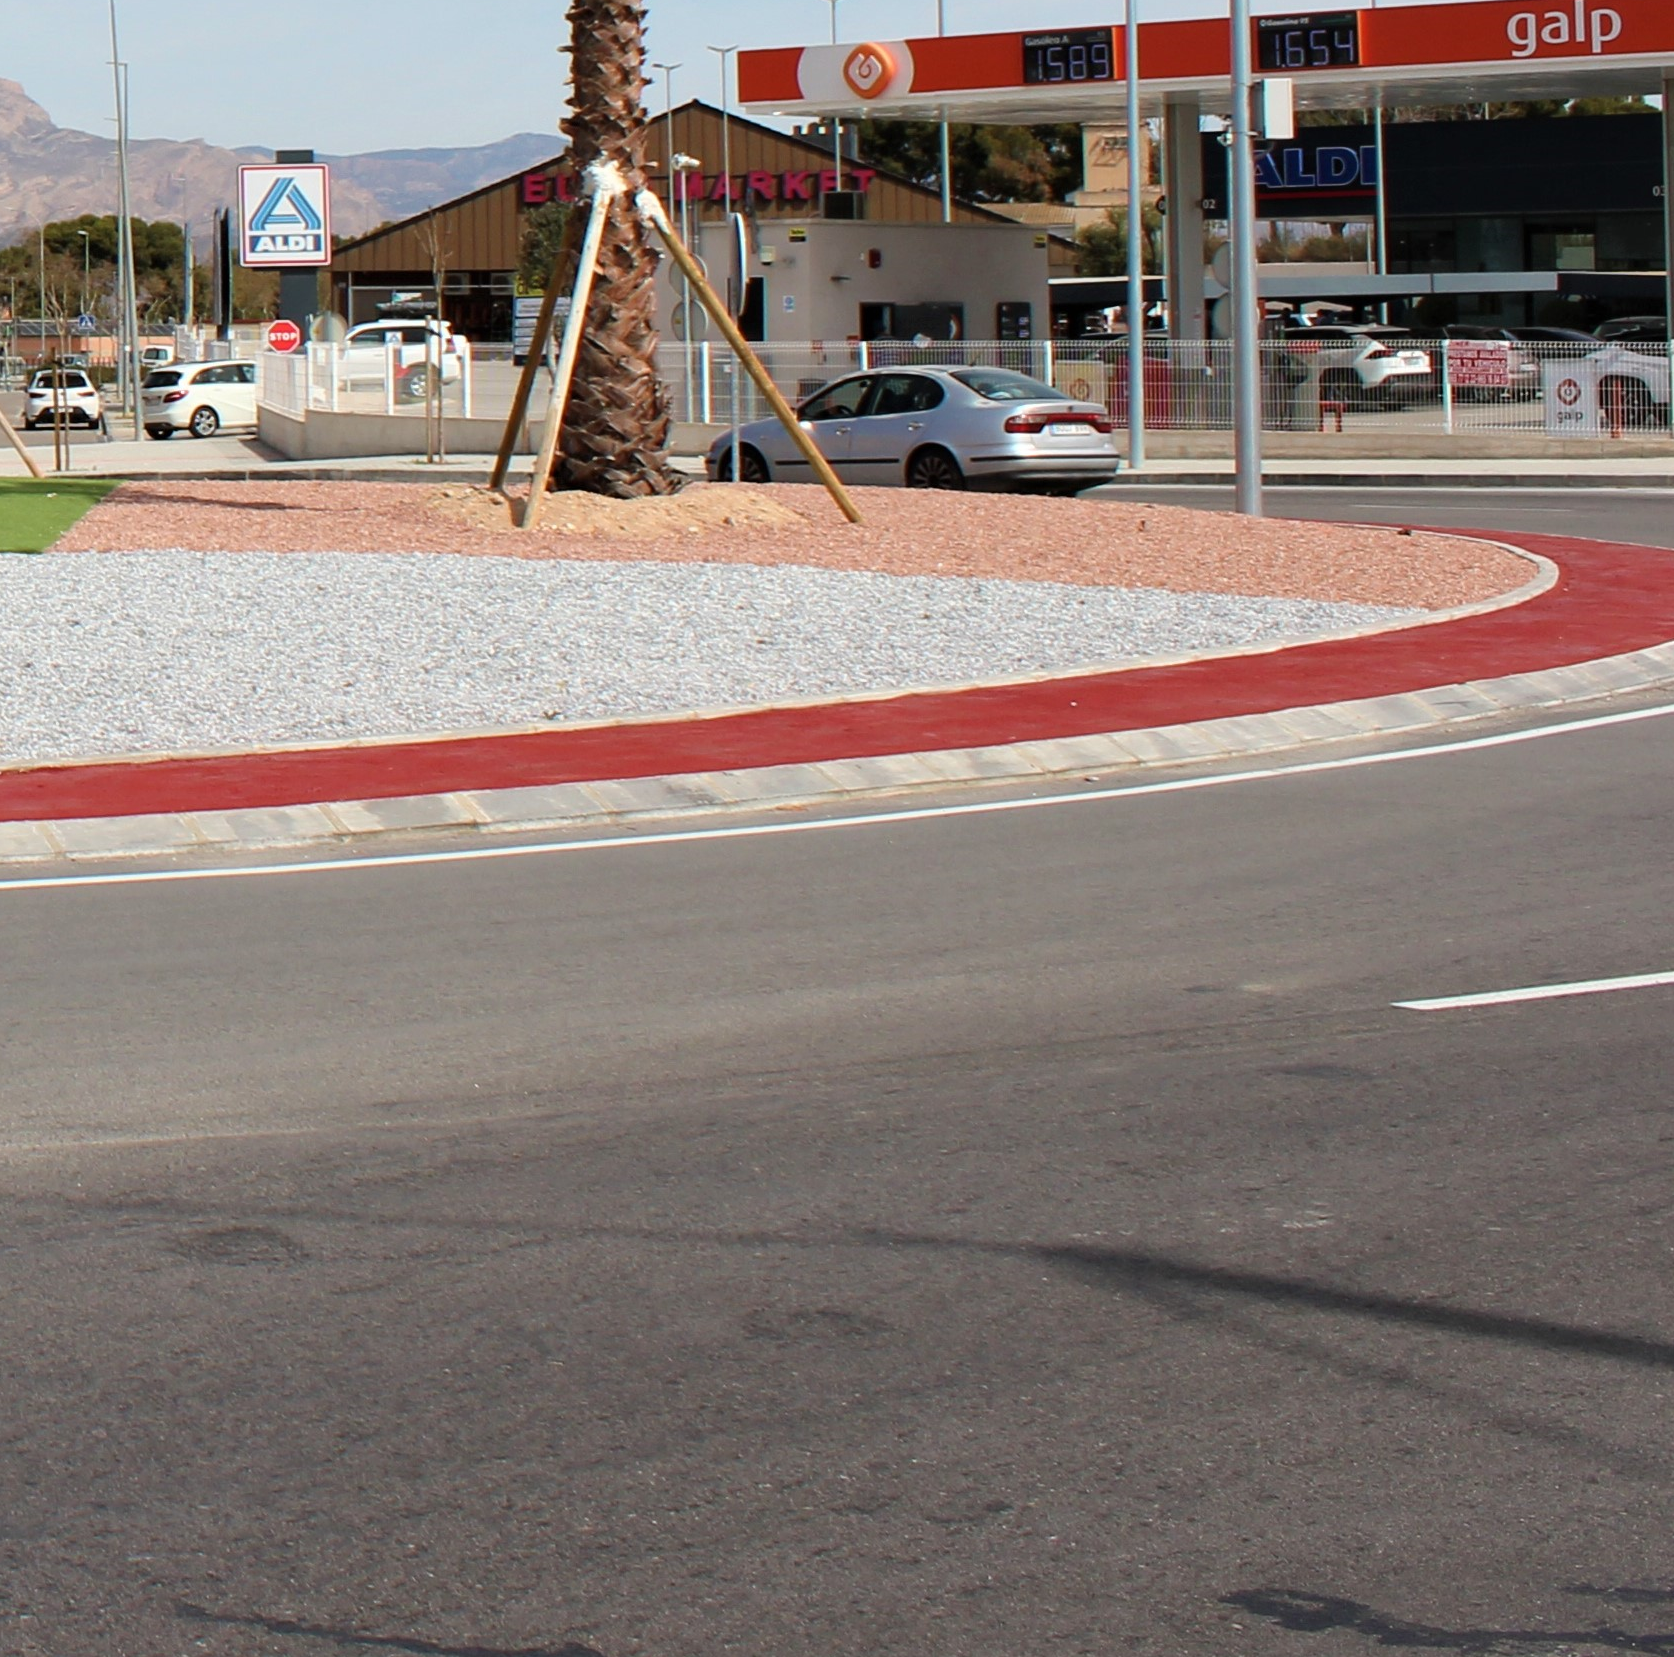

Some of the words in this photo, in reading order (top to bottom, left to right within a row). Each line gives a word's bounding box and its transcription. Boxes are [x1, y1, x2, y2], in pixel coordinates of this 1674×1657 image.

[1274, 28, 1354, 67] 1.654
[1037, 44, 1109, 81] 1.589
[674, 169, 877, 200] MARKET
[255, 235, 314, 252] ALDI
[269, 332, 298, 342] STOP
[1557, 411, 1583, 424] gap
